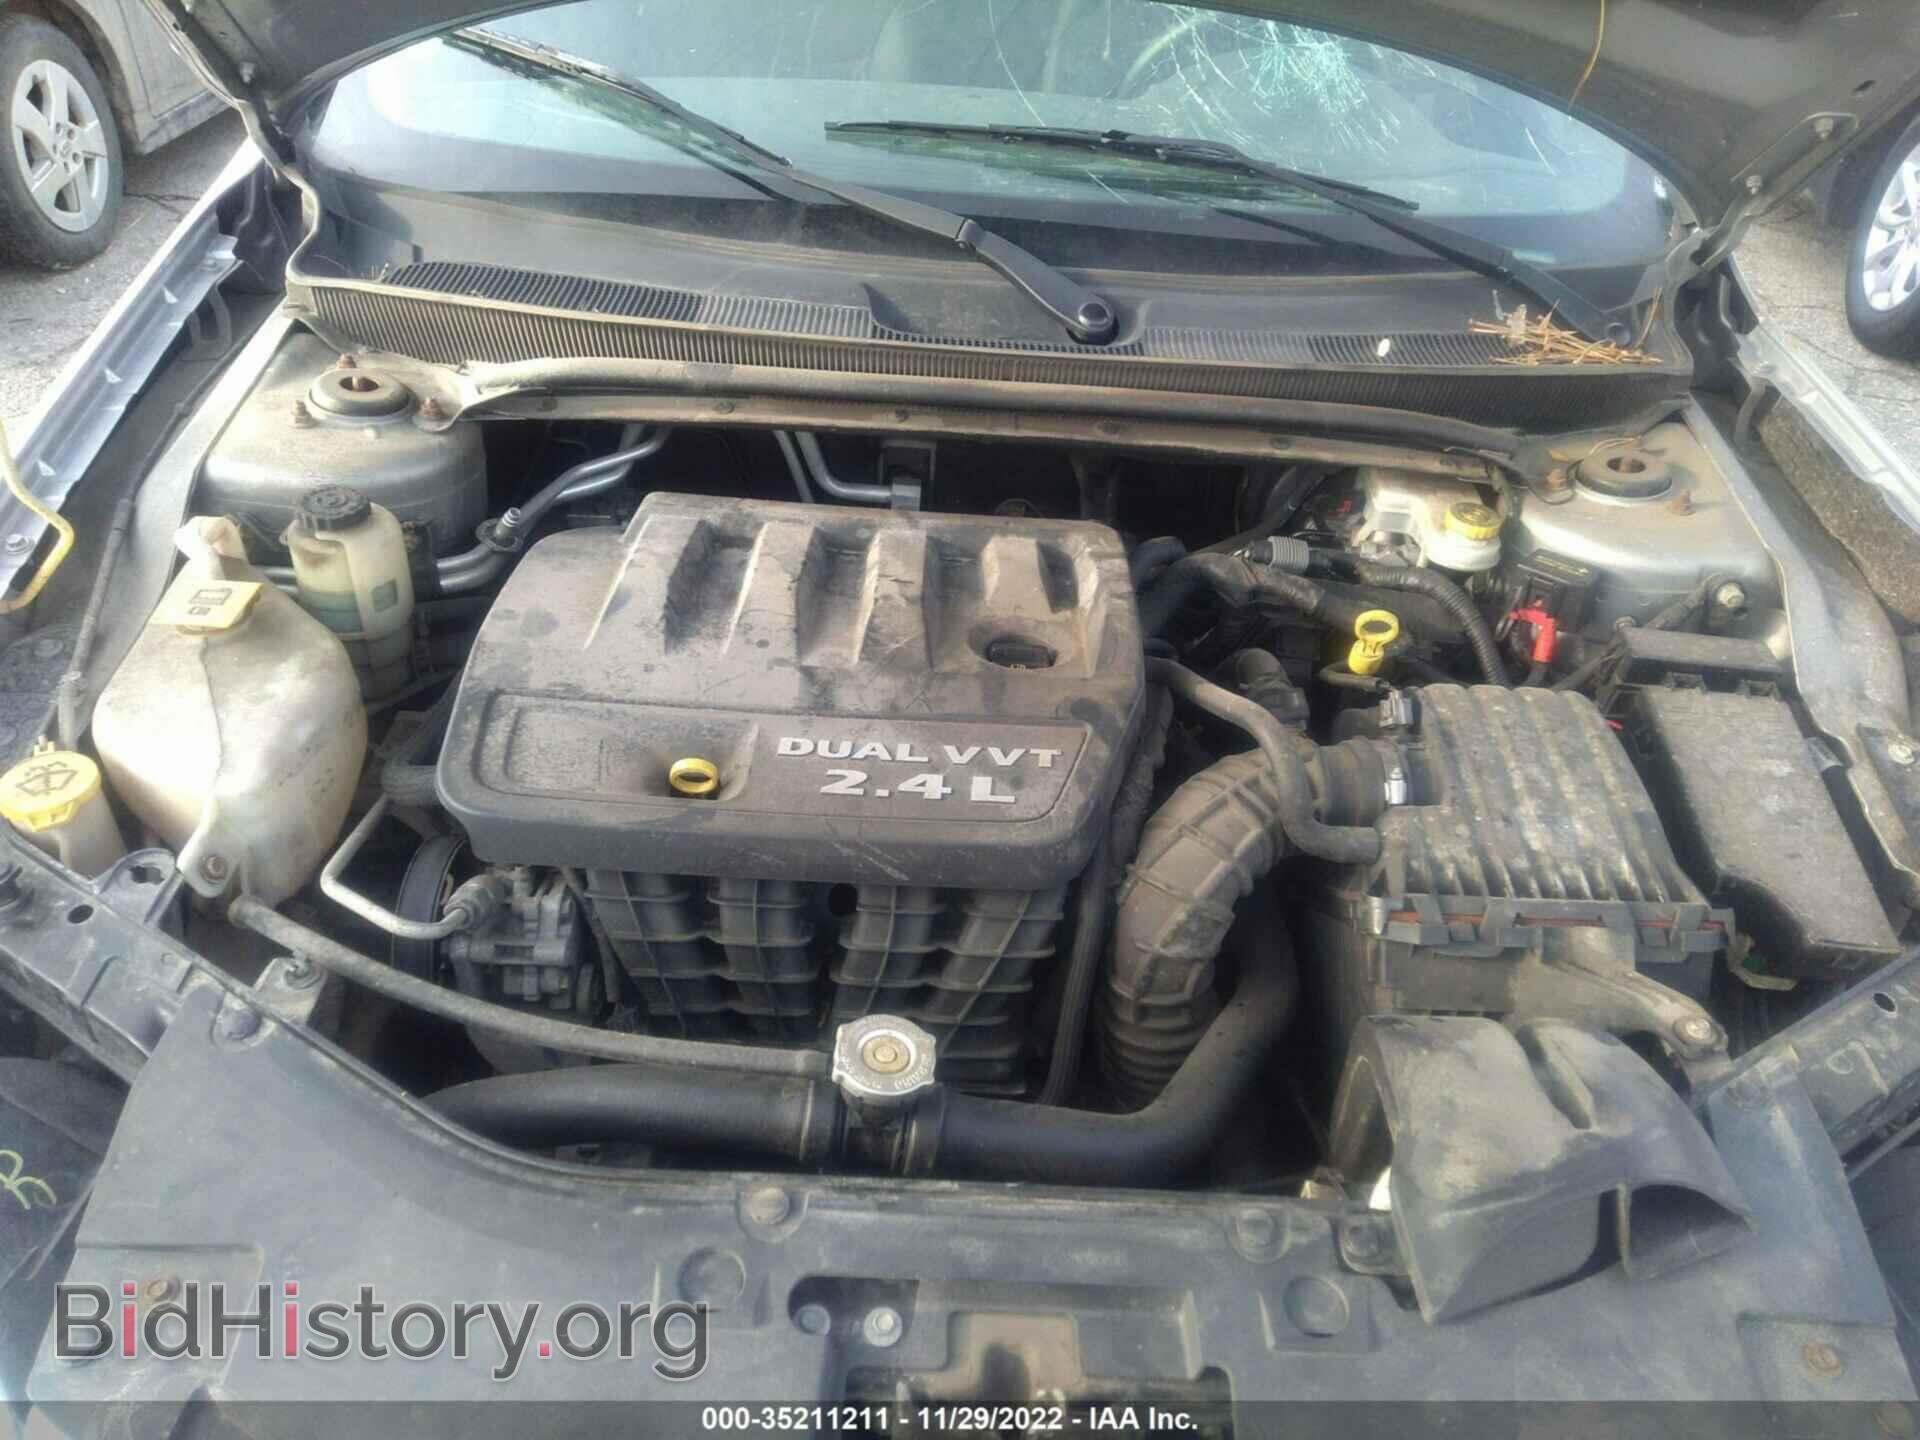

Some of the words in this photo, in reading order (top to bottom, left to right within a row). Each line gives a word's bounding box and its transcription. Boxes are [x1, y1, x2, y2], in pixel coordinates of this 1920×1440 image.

[777, 736, 929, 763] DUAL
[943, 745, 1062, 767] VVT
[820, 769, 952, 800] 2.4
[970, 776, 1015, 803] L
